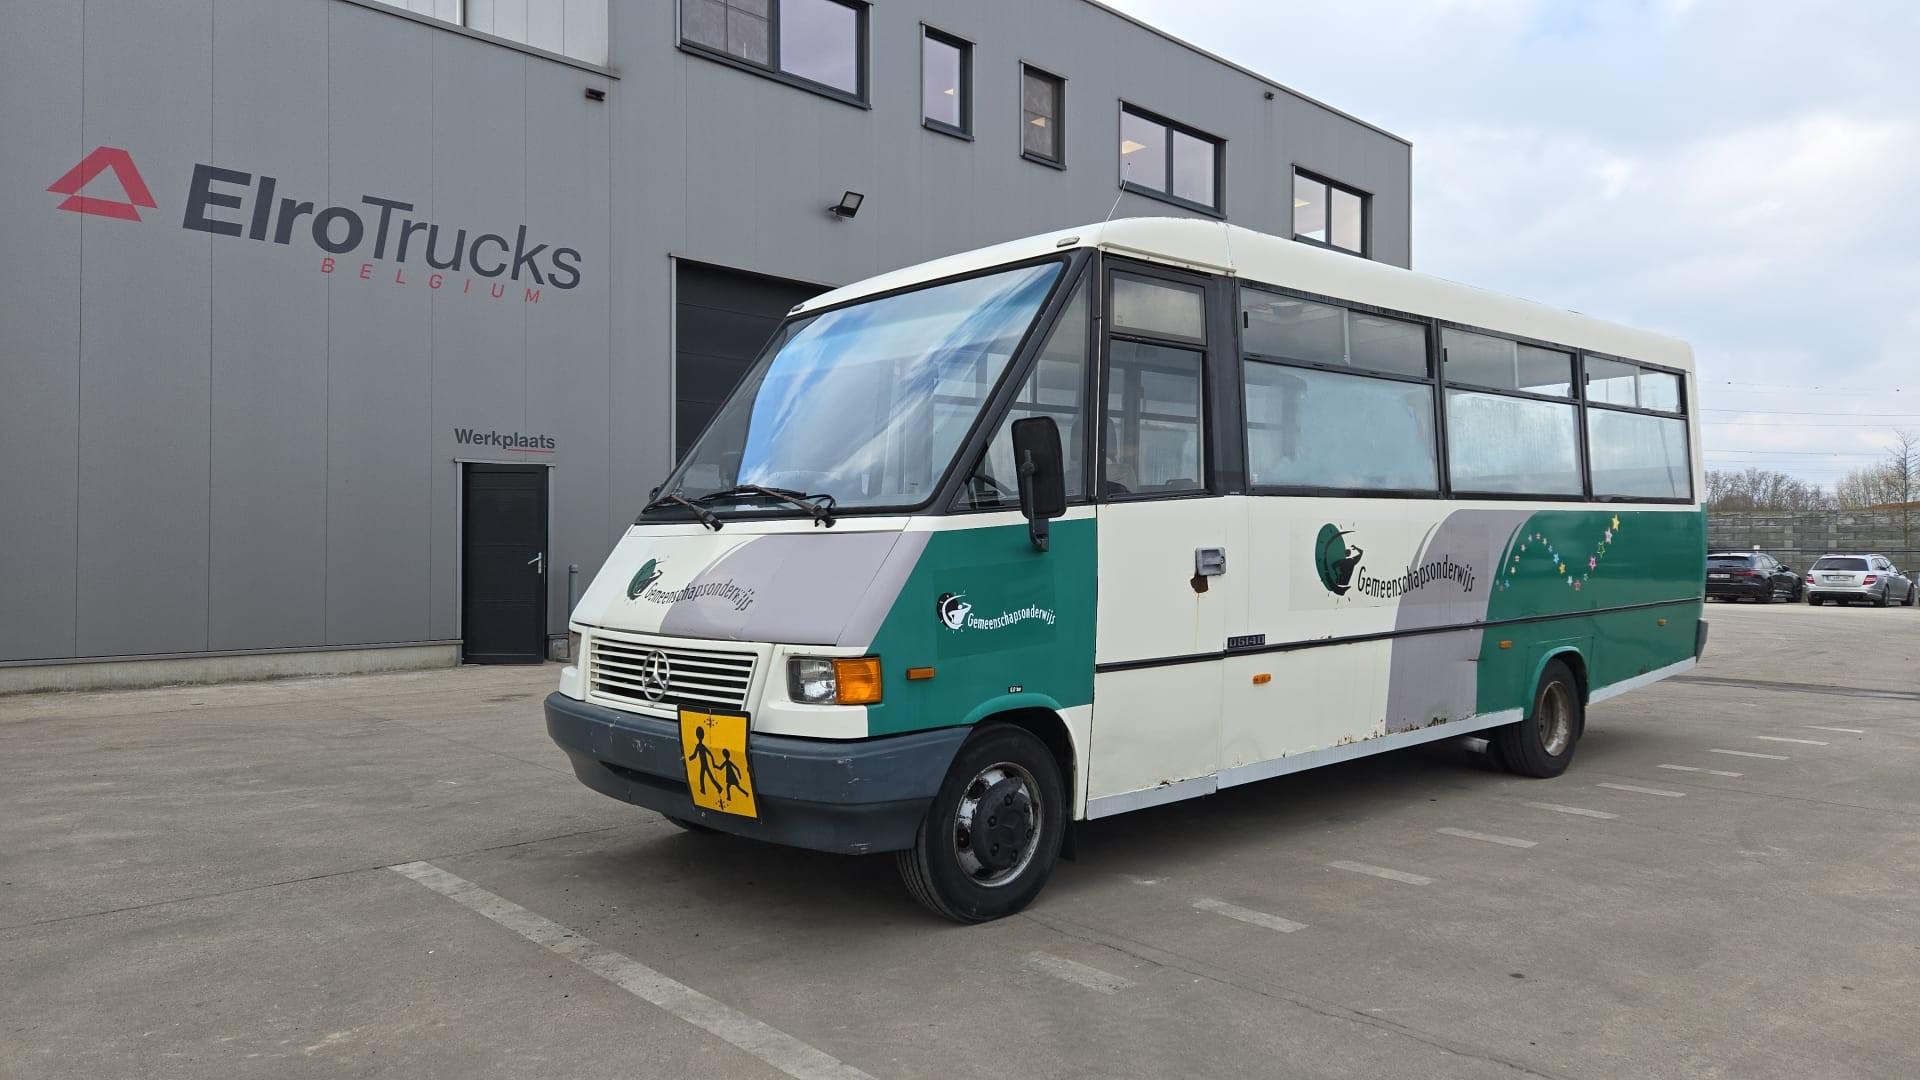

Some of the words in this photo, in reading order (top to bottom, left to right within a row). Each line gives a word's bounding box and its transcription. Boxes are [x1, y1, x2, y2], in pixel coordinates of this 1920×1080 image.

[182, 163, 582, 290] ElroTrucks
[320, 257, 542, 303] BELGIUM
[454, 428, 556, 450] Werkplaats
[644, 578, 755, 611] Gemeenschapsonderwijs
[1357, 554, 1476, 599] Gemeenschapsonderwijs
[967, 603, 1057, 630] Gemeenschapsonderwijs
